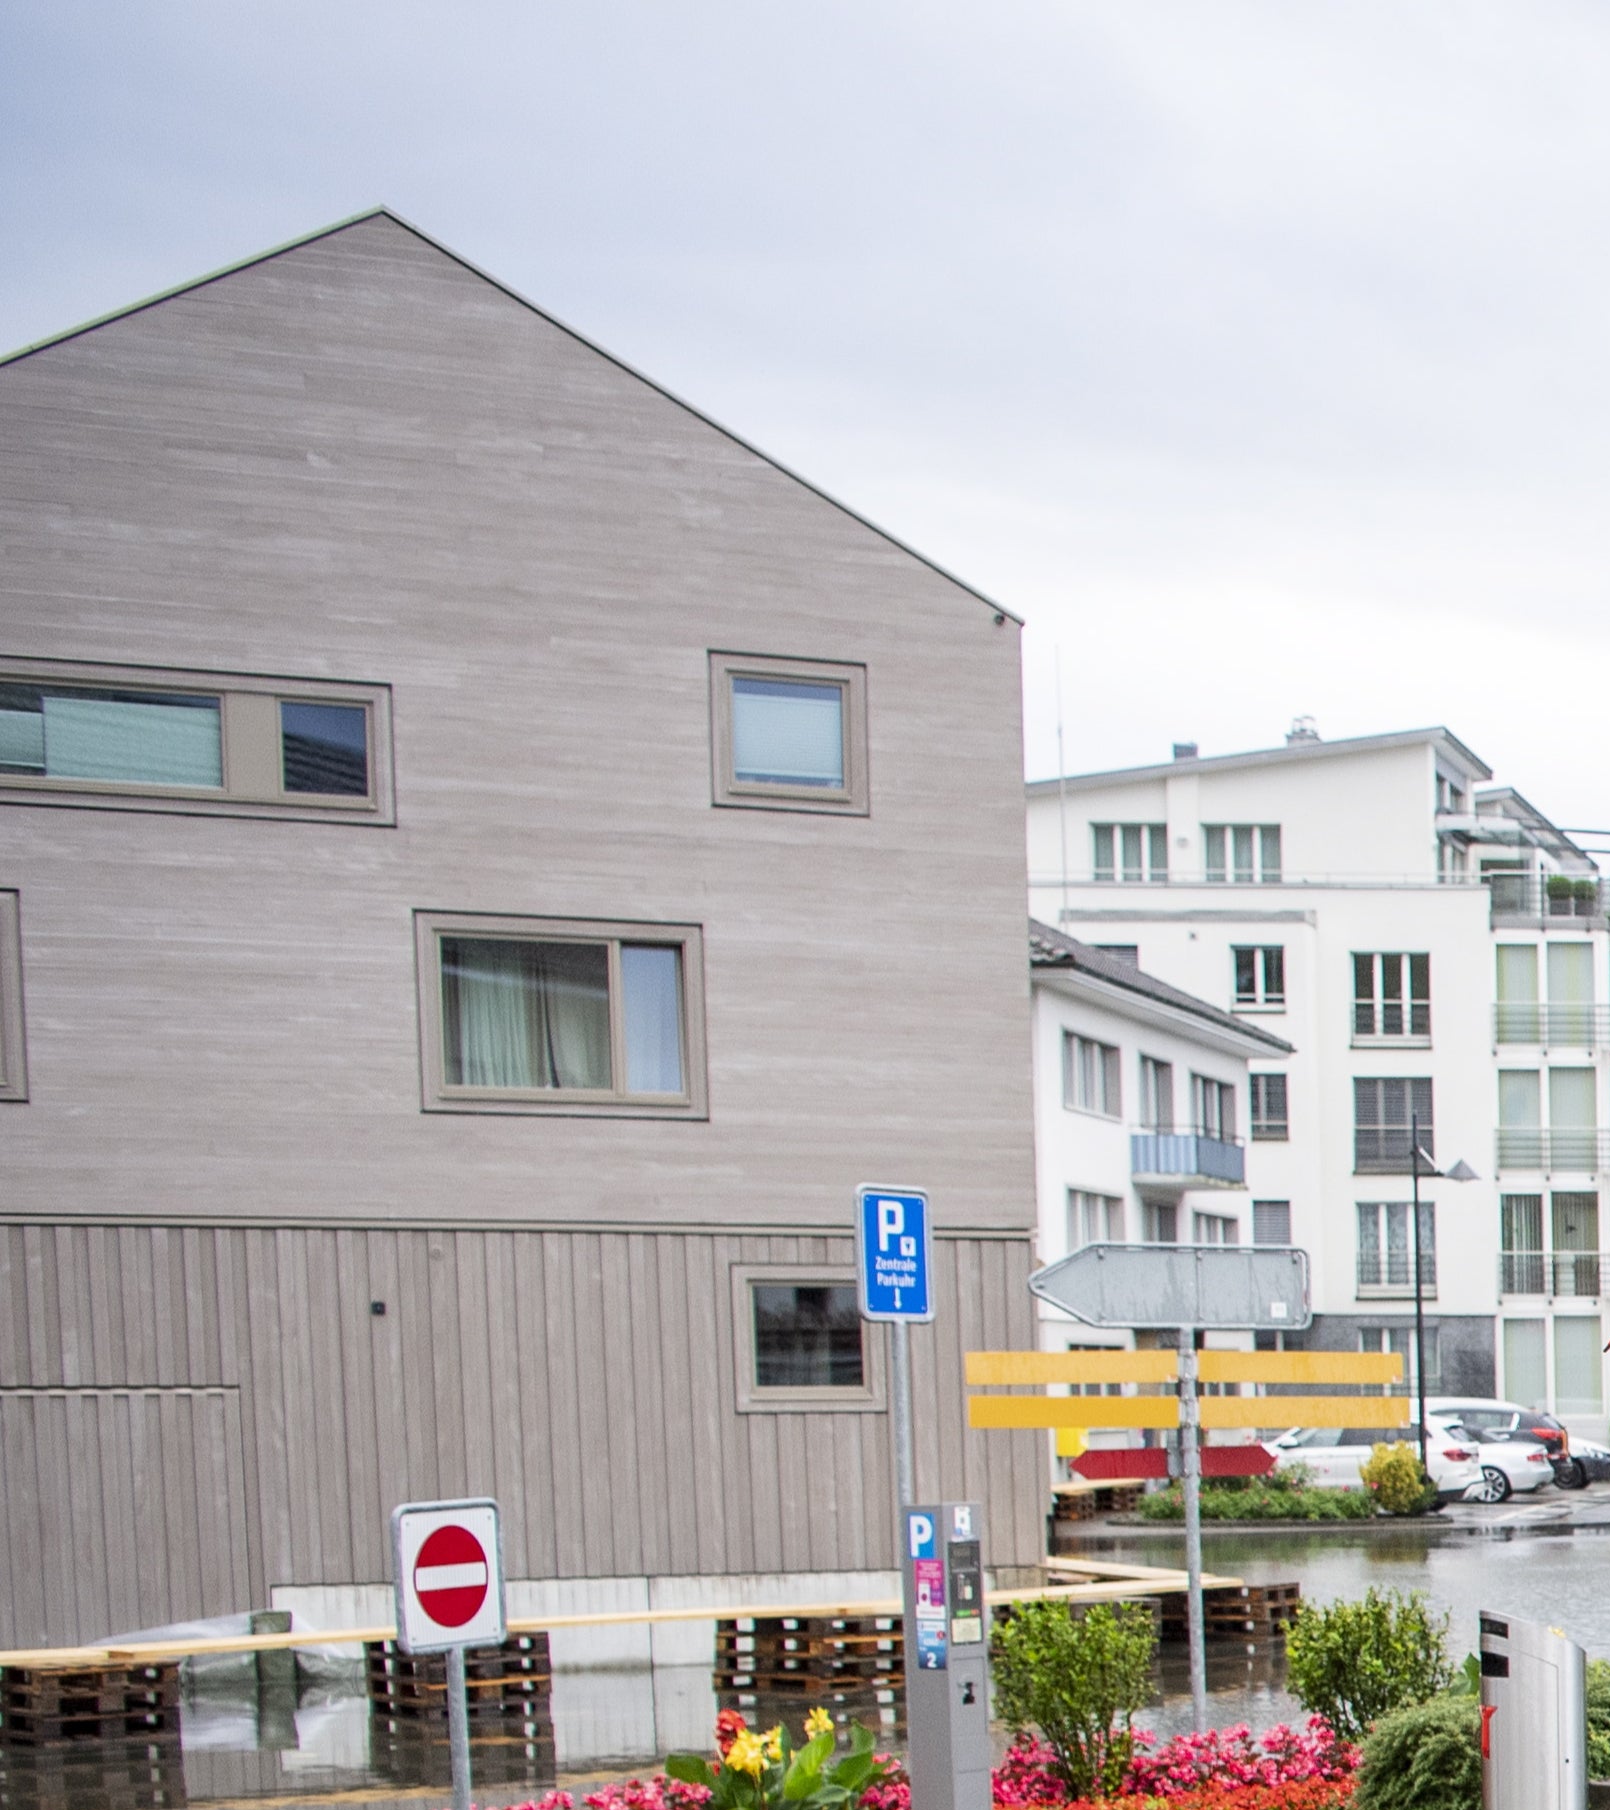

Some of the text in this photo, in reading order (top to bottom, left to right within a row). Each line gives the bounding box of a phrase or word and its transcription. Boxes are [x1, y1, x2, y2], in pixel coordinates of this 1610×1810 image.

[878, 1200, 905, 1251] P
[875, 1256, 917, 1272] Zentrale
[877, 1271, 917, 1288] Parkuhr
[909, 1515, 933, 1557] P
[926, 1652, 938, 1669] 2
